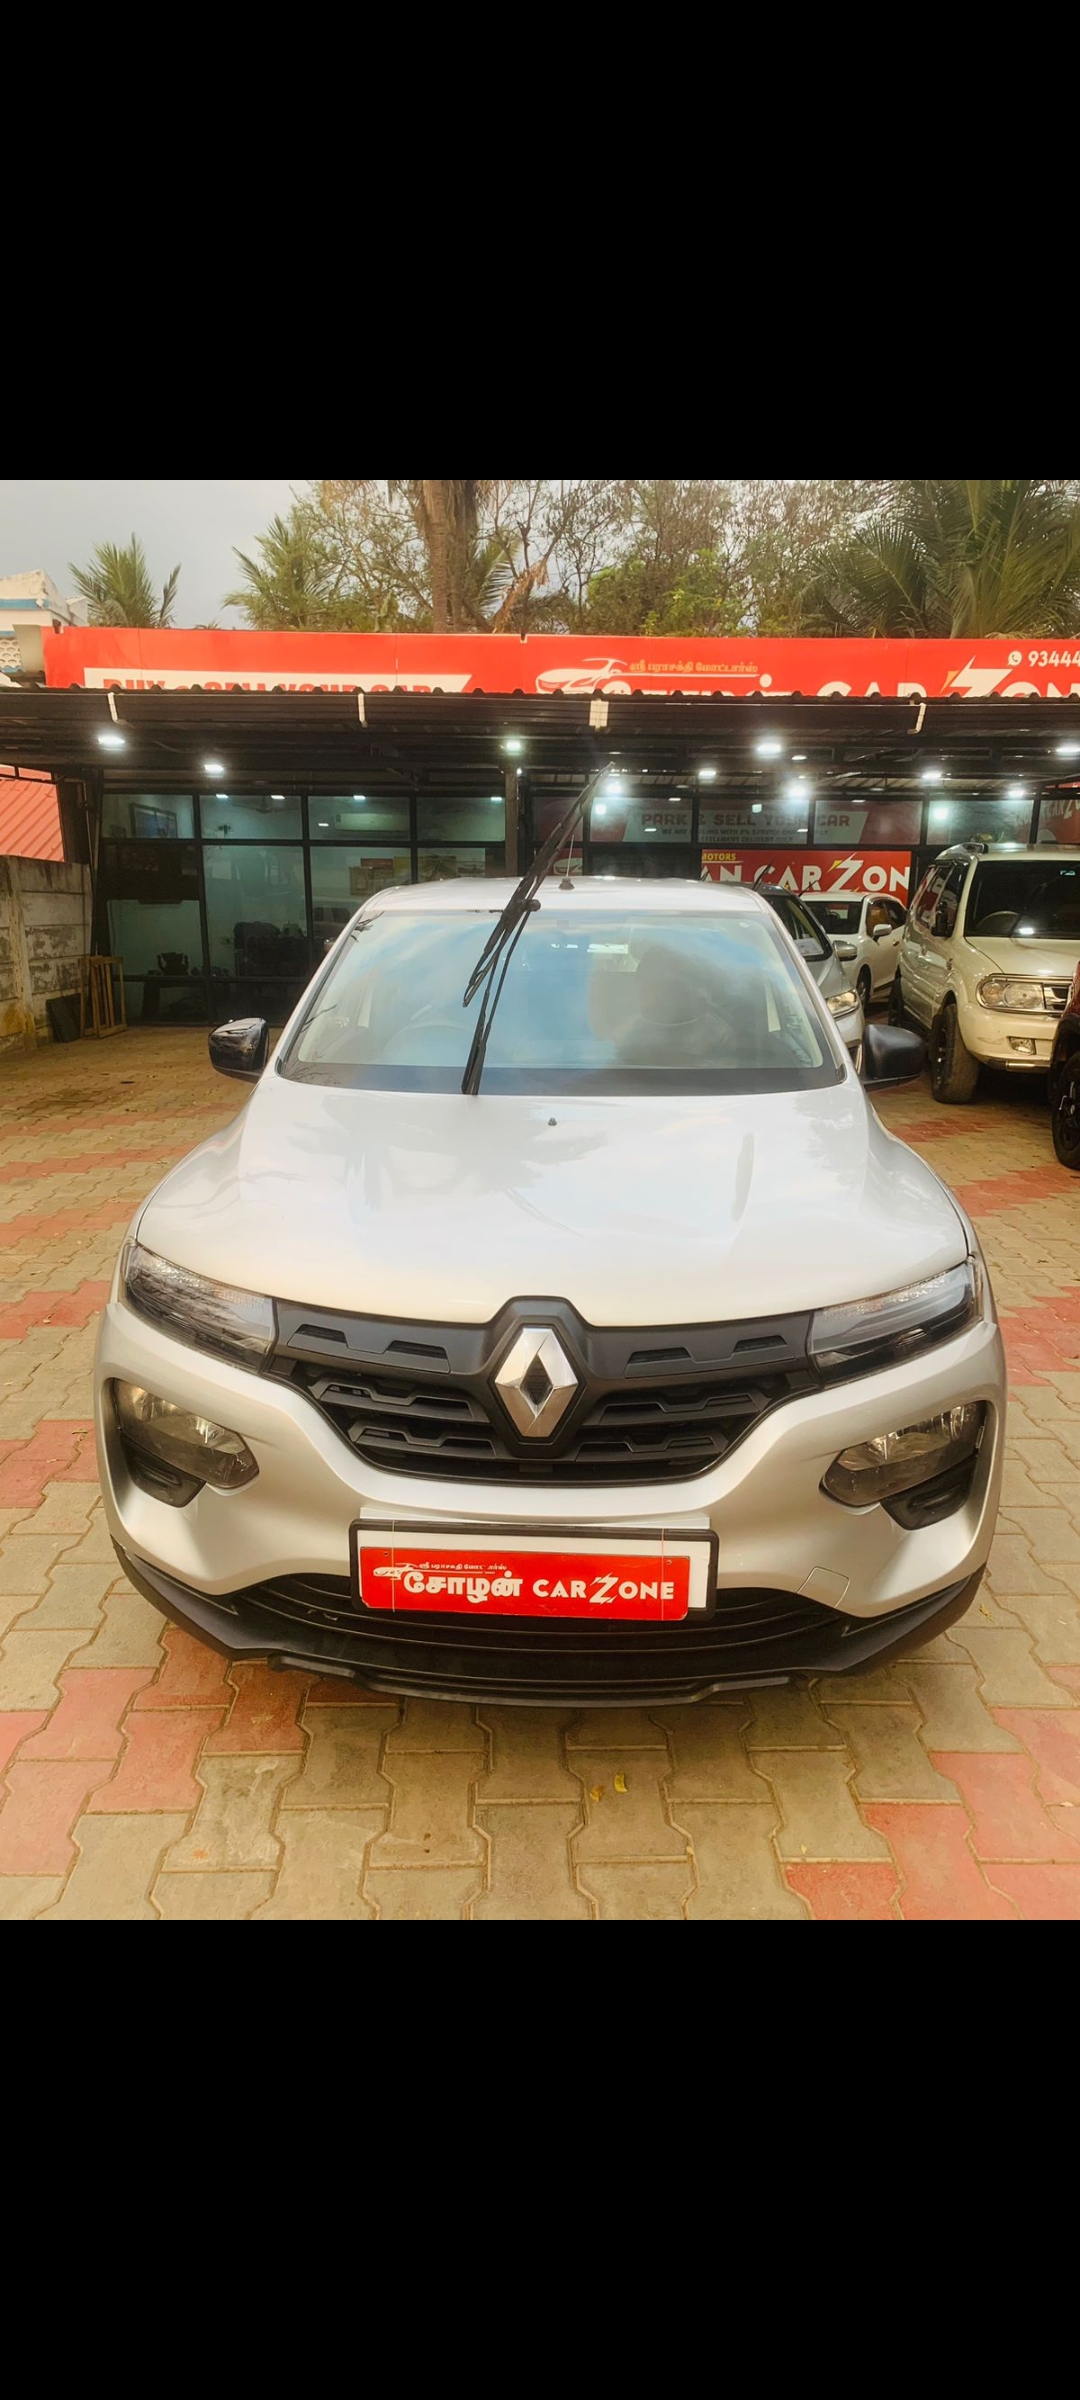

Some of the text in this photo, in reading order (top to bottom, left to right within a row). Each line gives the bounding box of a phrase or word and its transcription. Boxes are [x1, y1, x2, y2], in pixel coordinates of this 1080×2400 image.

[641, 813, 688, 825] PARK
[713, 814, 756, 826] SELL
[817, 814, 850, 827] CAR
[403, 1570, 523, 1603] சோழன்
